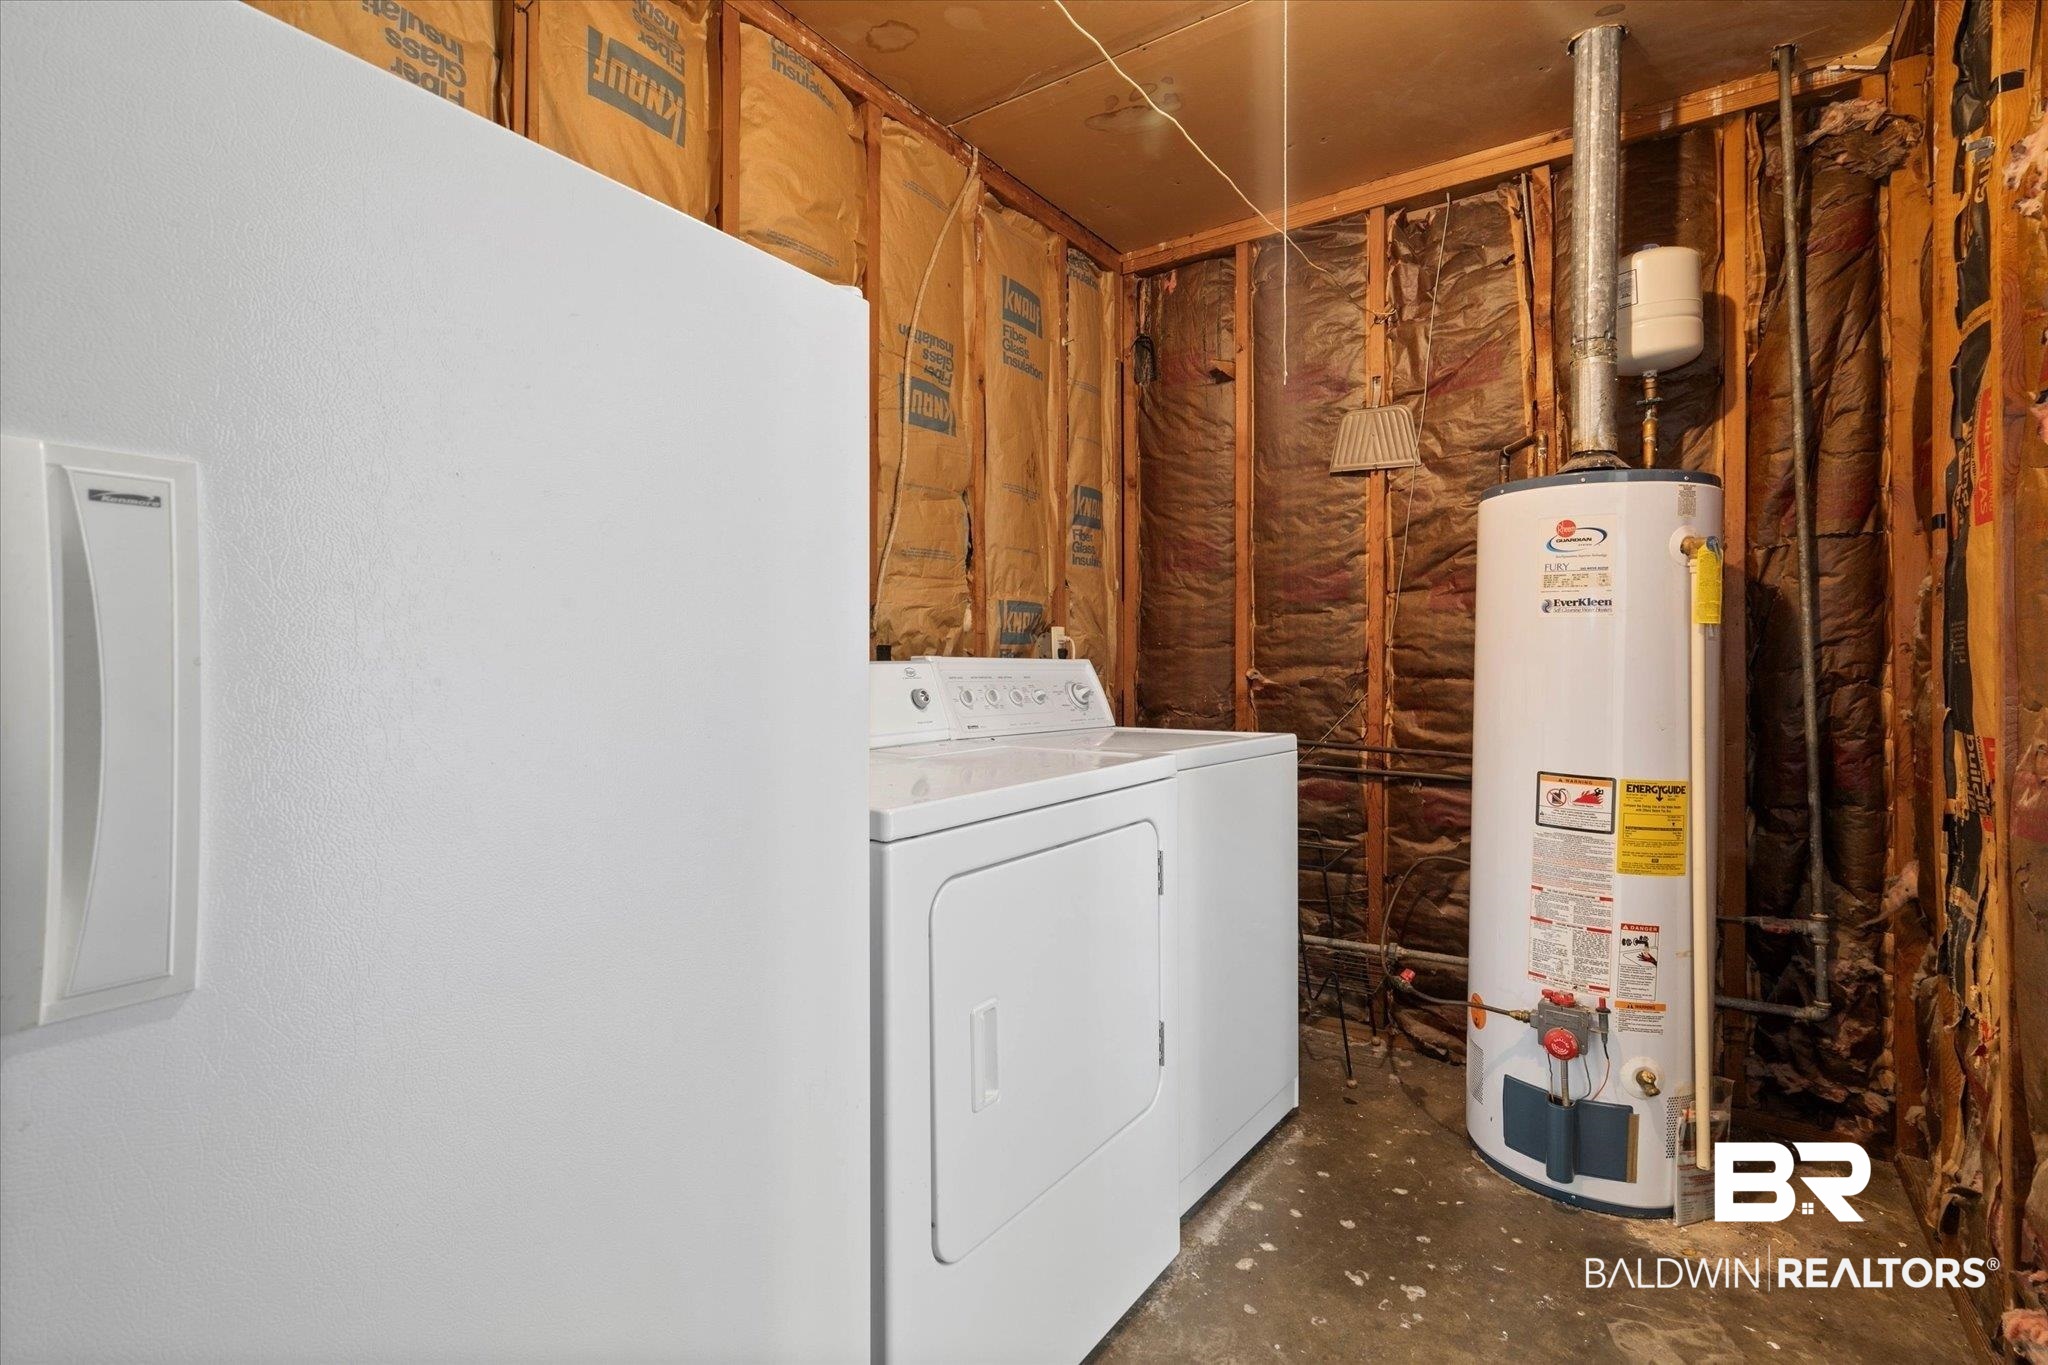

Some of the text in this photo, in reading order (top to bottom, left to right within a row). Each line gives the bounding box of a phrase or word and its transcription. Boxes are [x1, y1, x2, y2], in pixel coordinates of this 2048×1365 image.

[384, 27, 466, 88] Glass
[637, 31, 685, 77] Fiber
[592, 33, 683, 146] KNAUF
[1004, 279, 1041, 338] KNAUF
[1003, 324, 1027, 345] Fiber
[1002, 338, 1029, 360] Glass
[923, 348, 954, 373] Glass
[1003, 350, 1043, 381] Insulation
[100, 495, 161, 507] Kenmore
[1073, 529, 1094, 542] Fiber
[1072, 541, 1096, 556] Glass
[1544, 562, 1569, 571] FURY
[1553, 598, 1613, 607] EverKleen
[1626, 784, 1687, 797] ENERGYGUIDE
